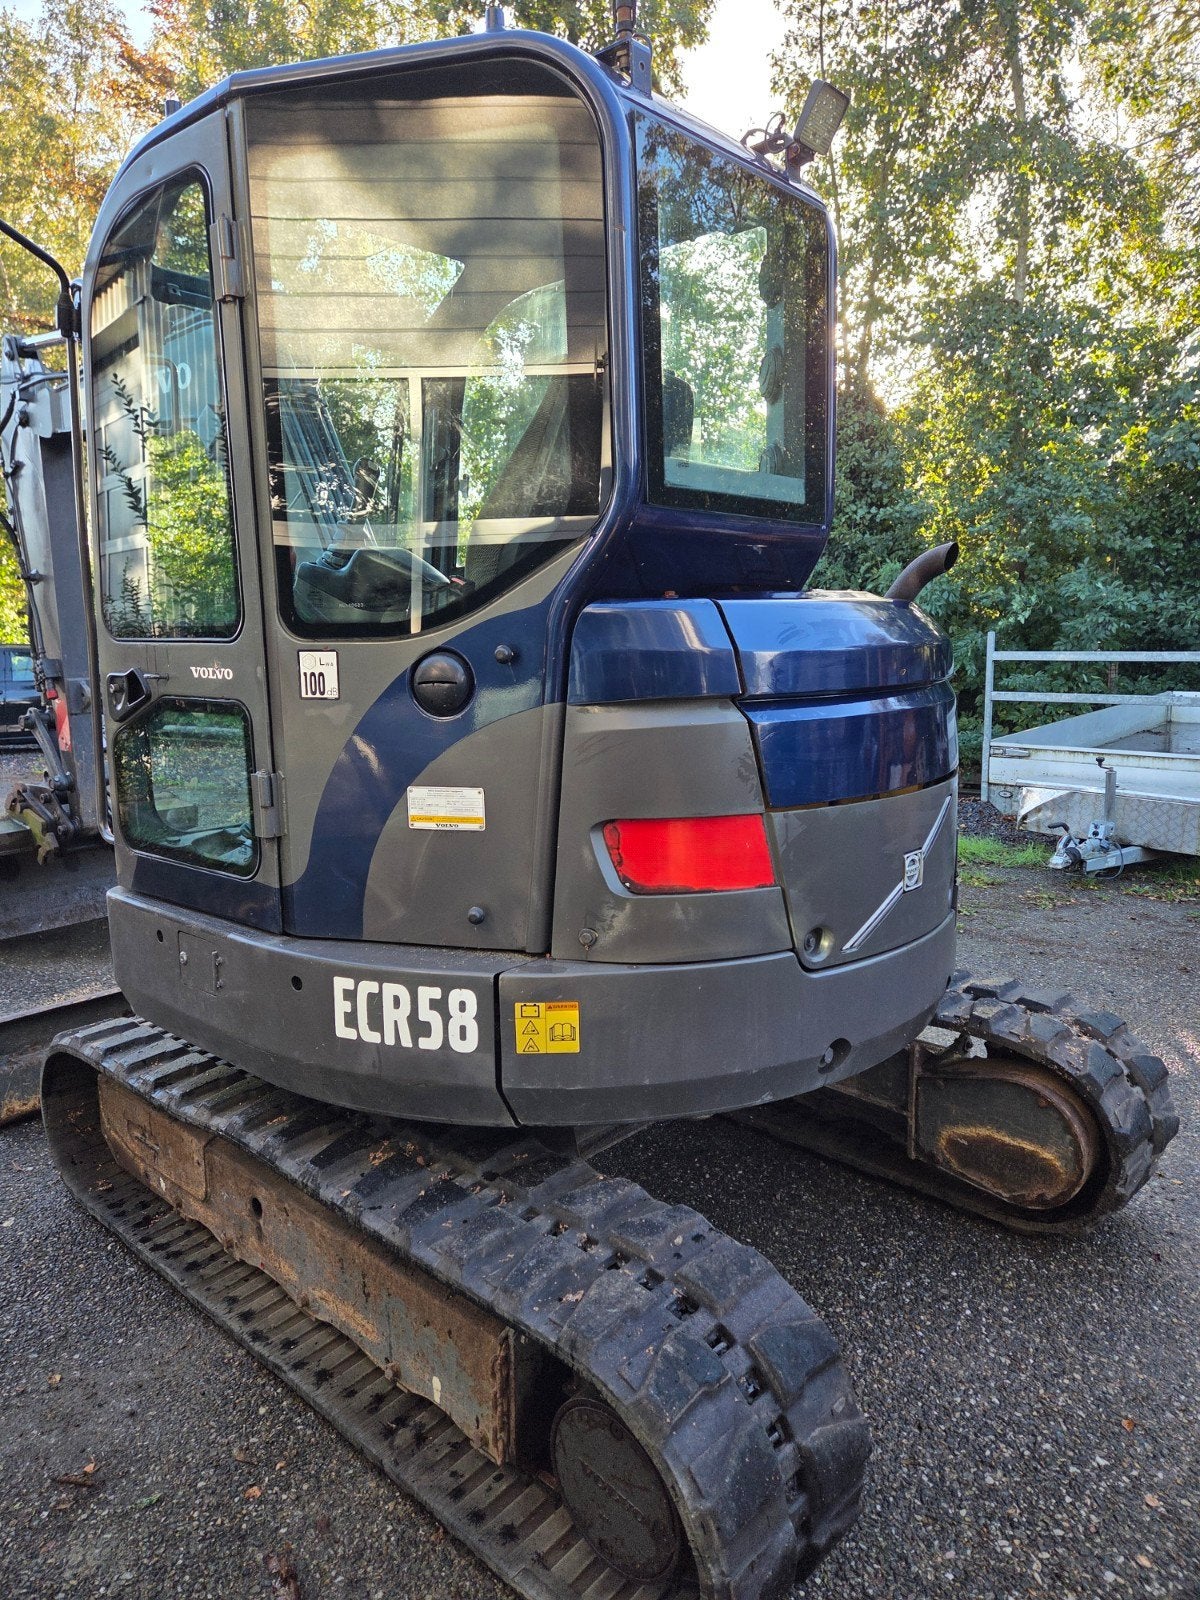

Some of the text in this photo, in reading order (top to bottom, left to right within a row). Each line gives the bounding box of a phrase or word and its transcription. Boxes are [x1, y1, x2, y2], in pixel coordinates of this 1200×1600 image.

[190, 666, 233, 680] VOLVO
[303, 671, 325, 696] 100
[333, 976, 479, 1054] ECR58
